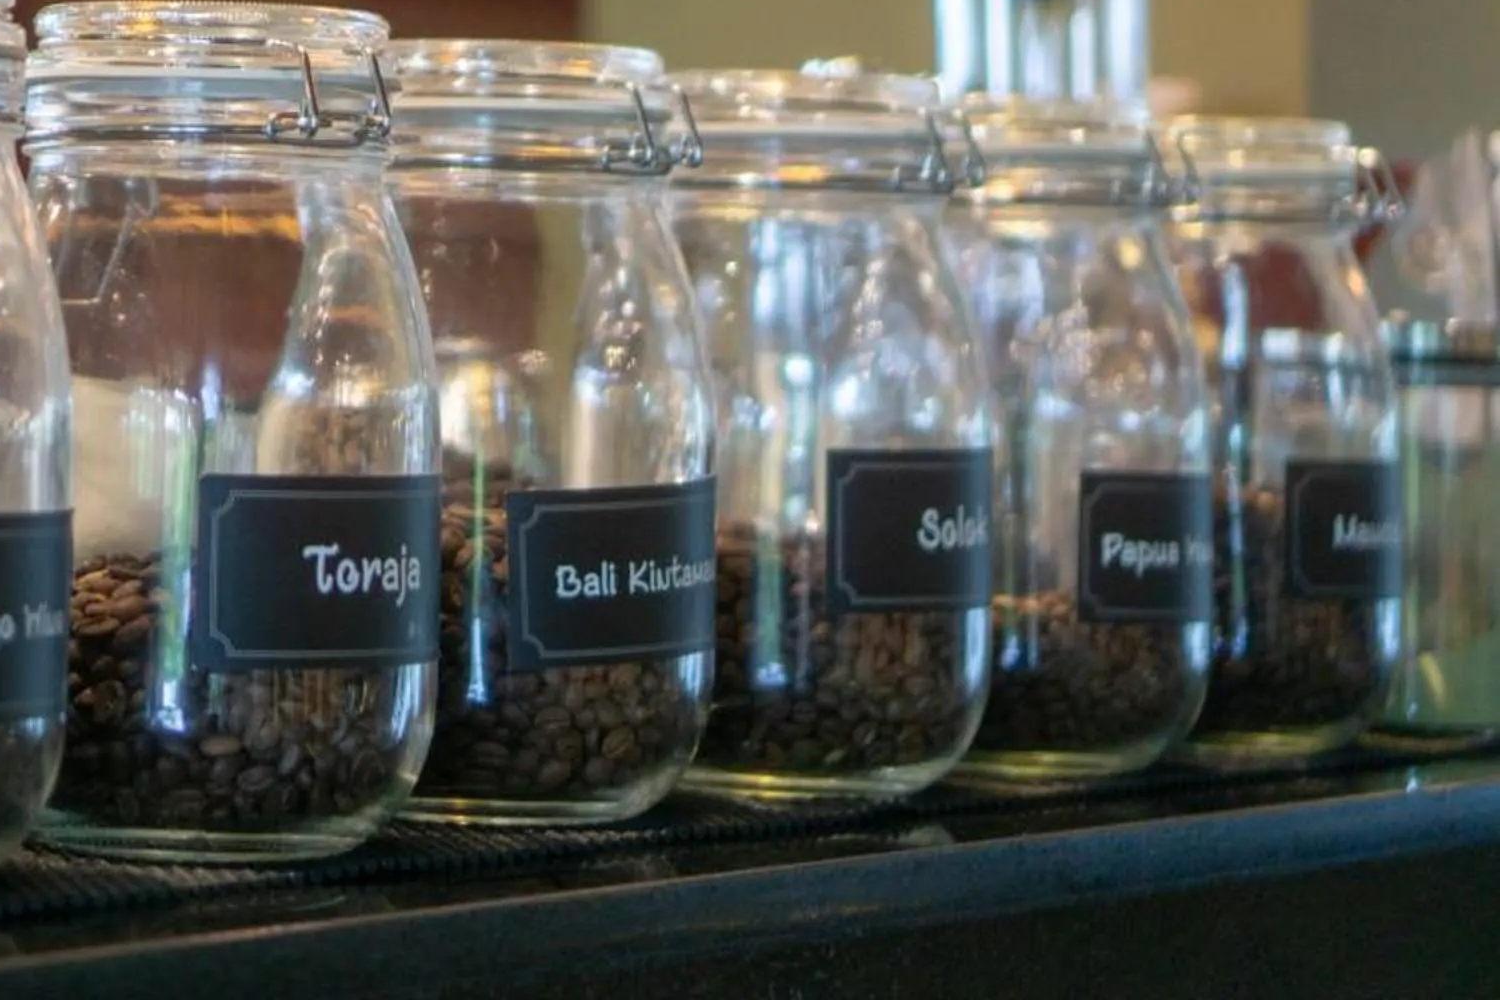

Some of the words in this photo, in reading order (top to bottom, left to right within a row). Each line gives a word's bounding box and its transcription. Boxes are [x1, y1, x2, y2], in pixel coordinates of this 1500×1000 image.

[303, 542, 421, 607] Toraja
[556, 560, 617, 598] Bali
[1101, 532, 1180, 579] Papua
